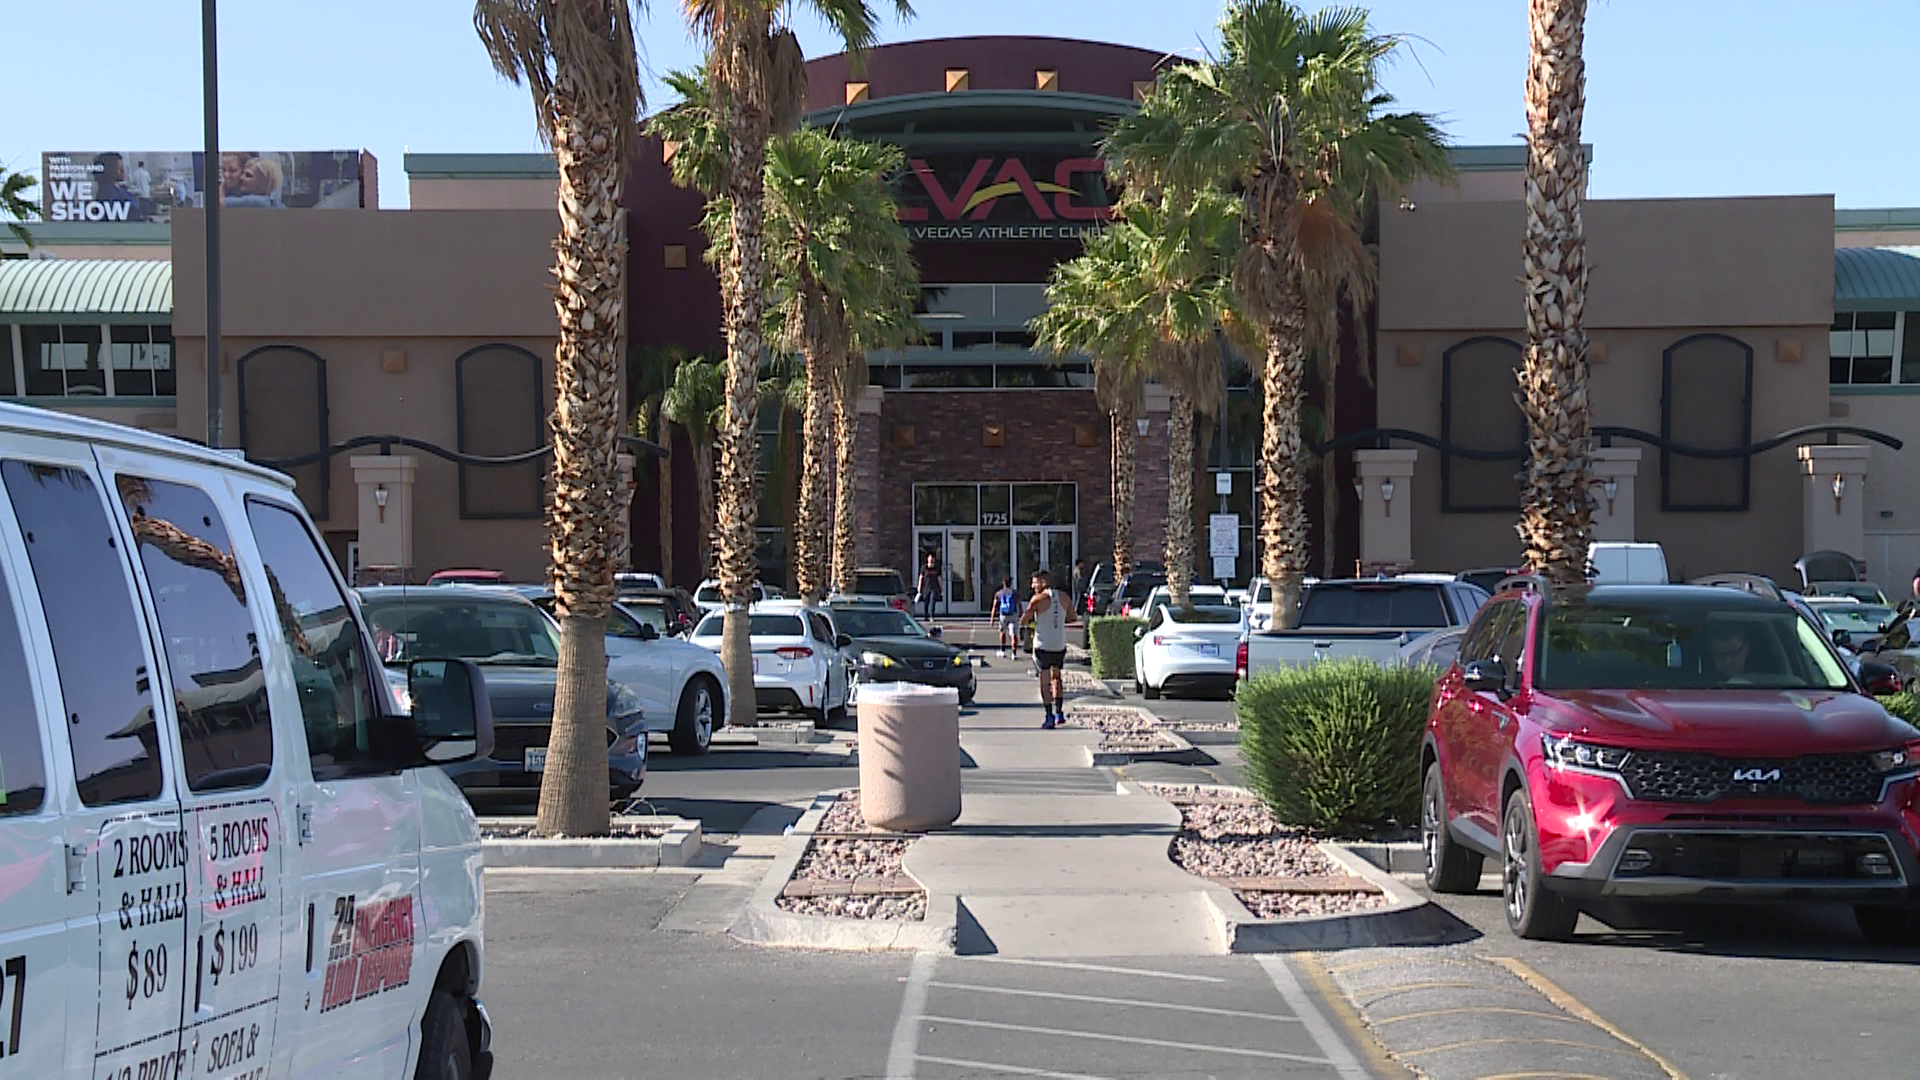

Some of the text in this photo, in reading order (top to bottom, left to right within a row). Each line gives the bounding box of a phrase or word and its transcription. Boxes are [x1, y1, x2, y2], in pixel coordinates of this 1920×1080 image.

[48, 156, 71, 164] WITH
[86, 164, 104, 172] AND
[49, 181, 93, 200] WE
[51, 201, 131, 221] SHOW
[914, 227, 973, 239] VEGAS
[978, 227, 1053, 239] ATHLETIC
[982, 512, 1008, 525] 1725
[113, 830, 189, 878] 2 ROOMS
[210, 816, 269, 862] 5 ROOMS
[214, 866, 266, 910] & HALL
[119, 882, 184, 930] & HALL
[331, 894, 355, 945] 24
[207, 1023, 259, 1073] SOFA &
